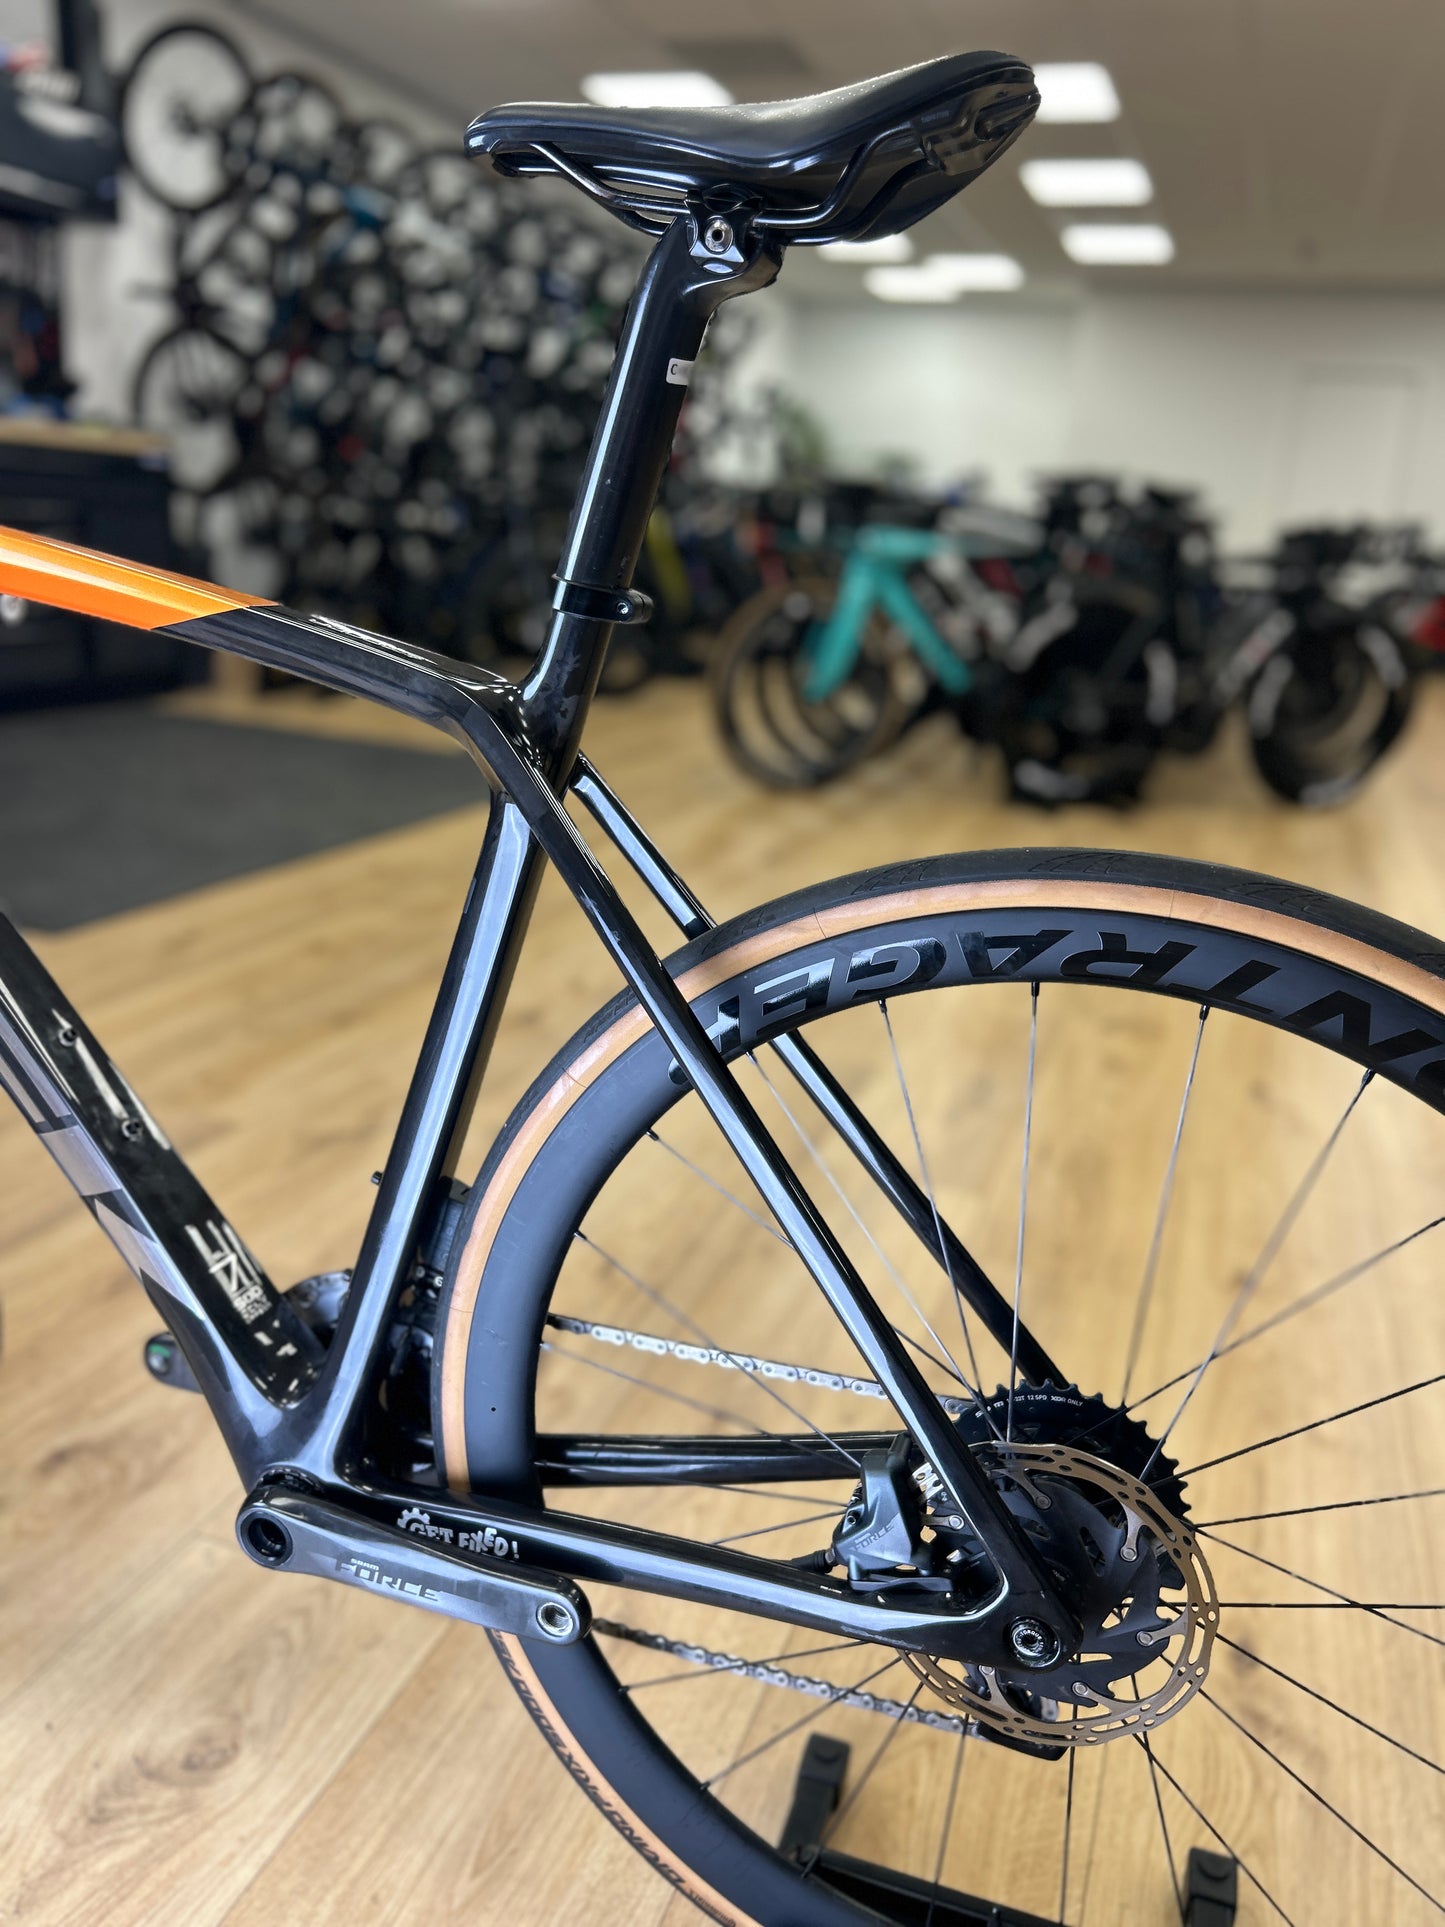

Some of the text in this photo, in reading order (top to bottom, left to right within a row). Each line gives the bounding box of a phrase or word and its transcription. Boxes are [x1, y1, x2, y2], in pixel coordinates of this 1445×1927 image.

[409, 1522, 454, 1544] GET
[853, 1523, 894, 1551] FORCE
[335, 1557, 439, 1602] FORCE
